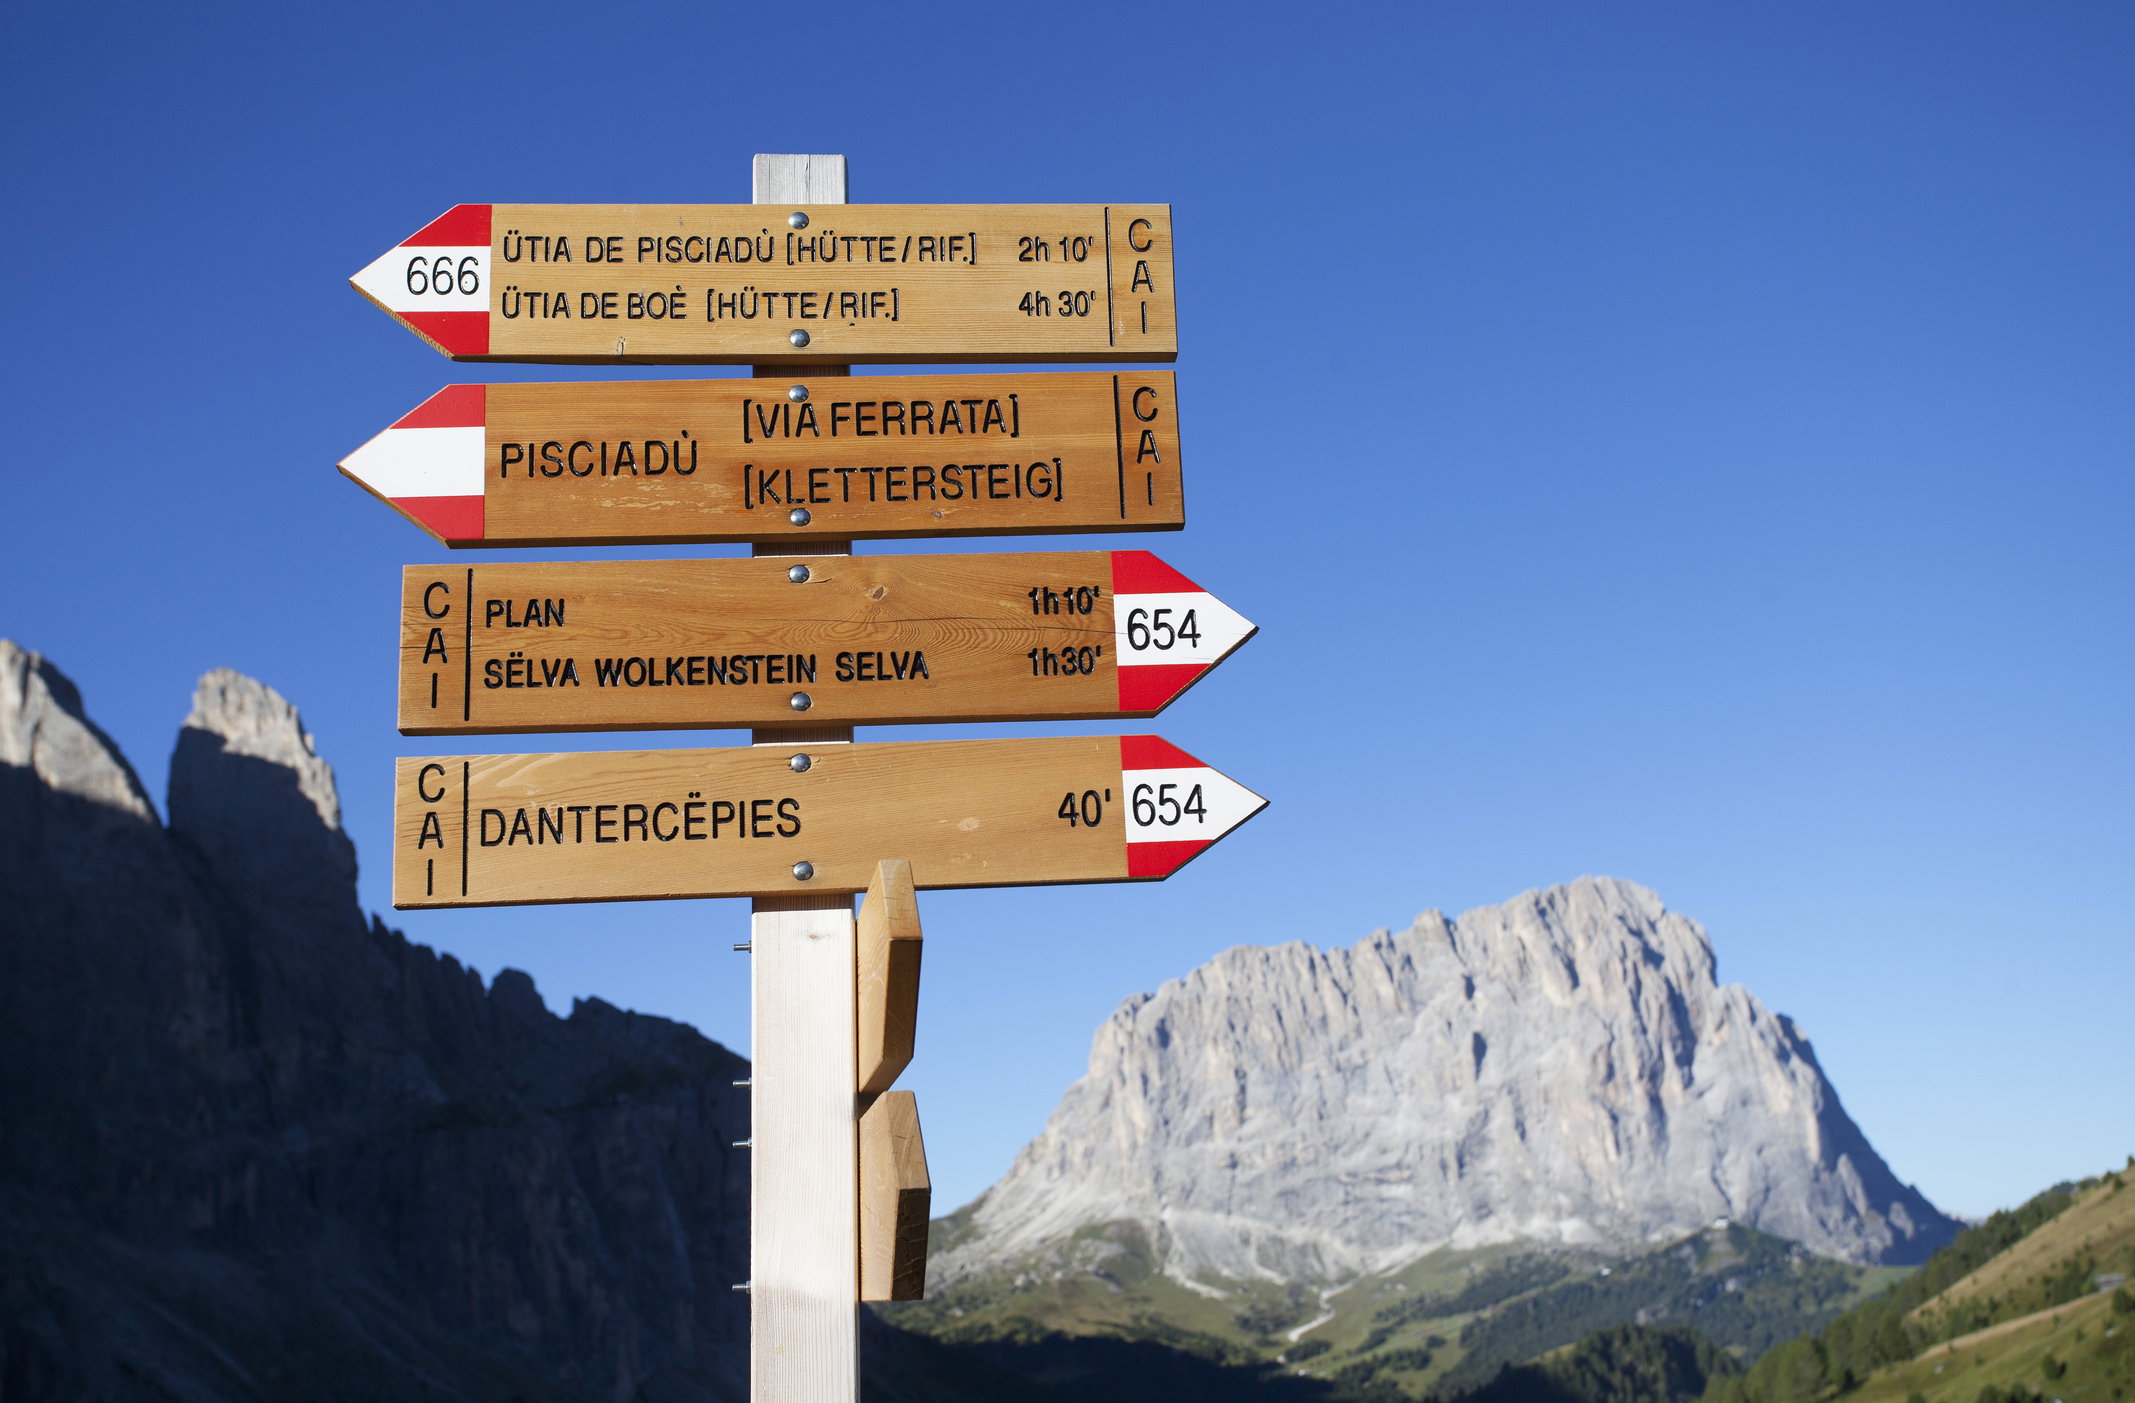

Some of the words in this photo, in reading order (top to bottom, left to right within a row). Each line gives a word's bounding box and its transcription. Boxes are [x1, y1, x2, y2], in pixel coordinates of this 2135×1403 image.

[503, 229, 573, 264] ÜTIA
[585, 236, 624, 263] DE
[637, 228, 776, 264] PISCIADÙ
[786, 230, 978, 266] [HÜTTE/RIF.]
[1018, 235, 1051, 263] 2h
[1059, 235, 1095, 263] 10'
[406, 256, 480, 295] 666
[501, 286, 572, 320] ÜTIA
[580, 292, 619, 319] DE
[627, 284, 688, 320] BOÈ
[706, 286, 899, 323] [HÜTTE/RIF.]
[1018, 290, 1051, 317] 4h
[1058, 290, 1096, 318] 30'
[743, 398, 820, 444] [VIA
[831, 393, 1020, 438] FERRATA]
[501, 429, 698, 479] PISCIADÙ
[743, 456, 1063, 510] [KLETTERSTEIG]
[485, 598, 565, 629] PLAN
[1127, 608, 1201, 651] 654
[483, 651, 581, 690] SËLVA
[594, 653, 817, 688] WOLKENSTEIN
[834, 650, 930, 682] SELVA
[480, 791, 802, 848] DANTERCËPIES
[1058, 788, 1111, 828] 40'
[1131, 783, 1208, 827] 654
